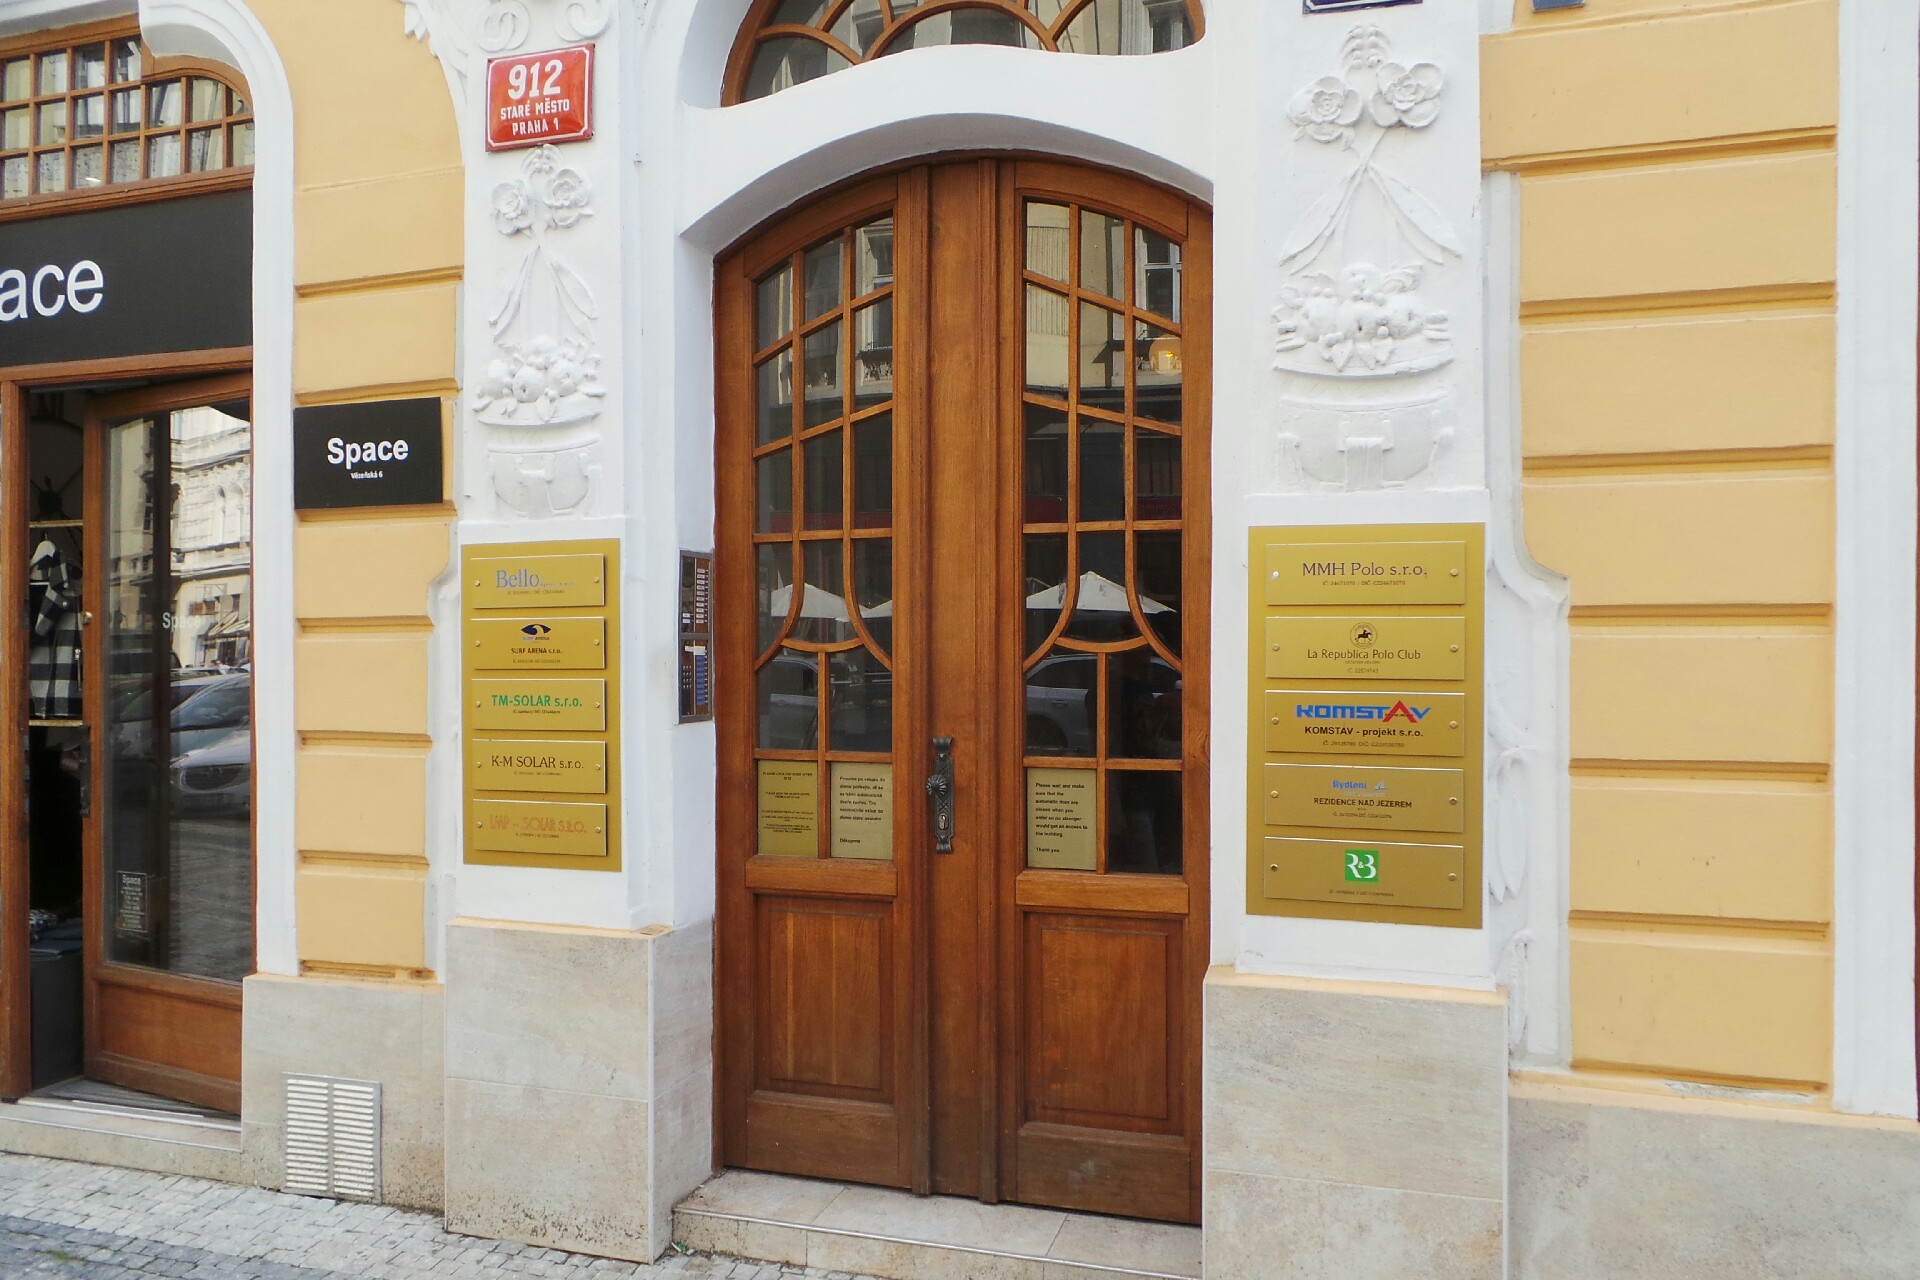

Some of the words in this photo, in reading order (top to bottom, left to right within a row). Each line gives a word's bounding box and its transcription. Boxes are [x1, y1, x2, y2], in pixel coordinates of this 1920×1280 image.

[508, 60, 562, 100] 912
[500, 100, 530, 120] STARÉ
[536, 98, 570, 116] MĚSTO
[512, 118, 548, 136] PRAHA
[553, 118, 559, 130] 1
[0, 260, 104, 321] ace
[328, 437, 409, 470] Space
[1302, 563, 1345, 576] MMH
[1351, 562, 1384, 576] Polo
[1390, 564, 1428, 576] s.r.o.
[496, 569, 540, 588] Bello
[1307, 649, 1318, 659] La
[1322, 648, 1368, 661] Republica
[1373, 649, 1394, 659] Polo
[1397, 649, 1420, 660] Club
[492, 695, 550, 707] TM-SOLAR
[554, 697, 582, 707] s.r.o.
[1296, 700, 1431, 723] KOMSTAV
[1305, 727, 1354, 735] KOMSTAV
[1362, 728, 1396, 738] projekt
[492, 756, 512, 767] K-M
[516, 756, 556, 768] SOLAR
[559, 761, 584, 769] s.r.o.
[1314, 798, 1356, 806] REZIDENCE
[1358, 799, 1374, 807] NAD
[1376, 800, 1412, 808] JEZEREM
[122, 874, 141, 885] Space
